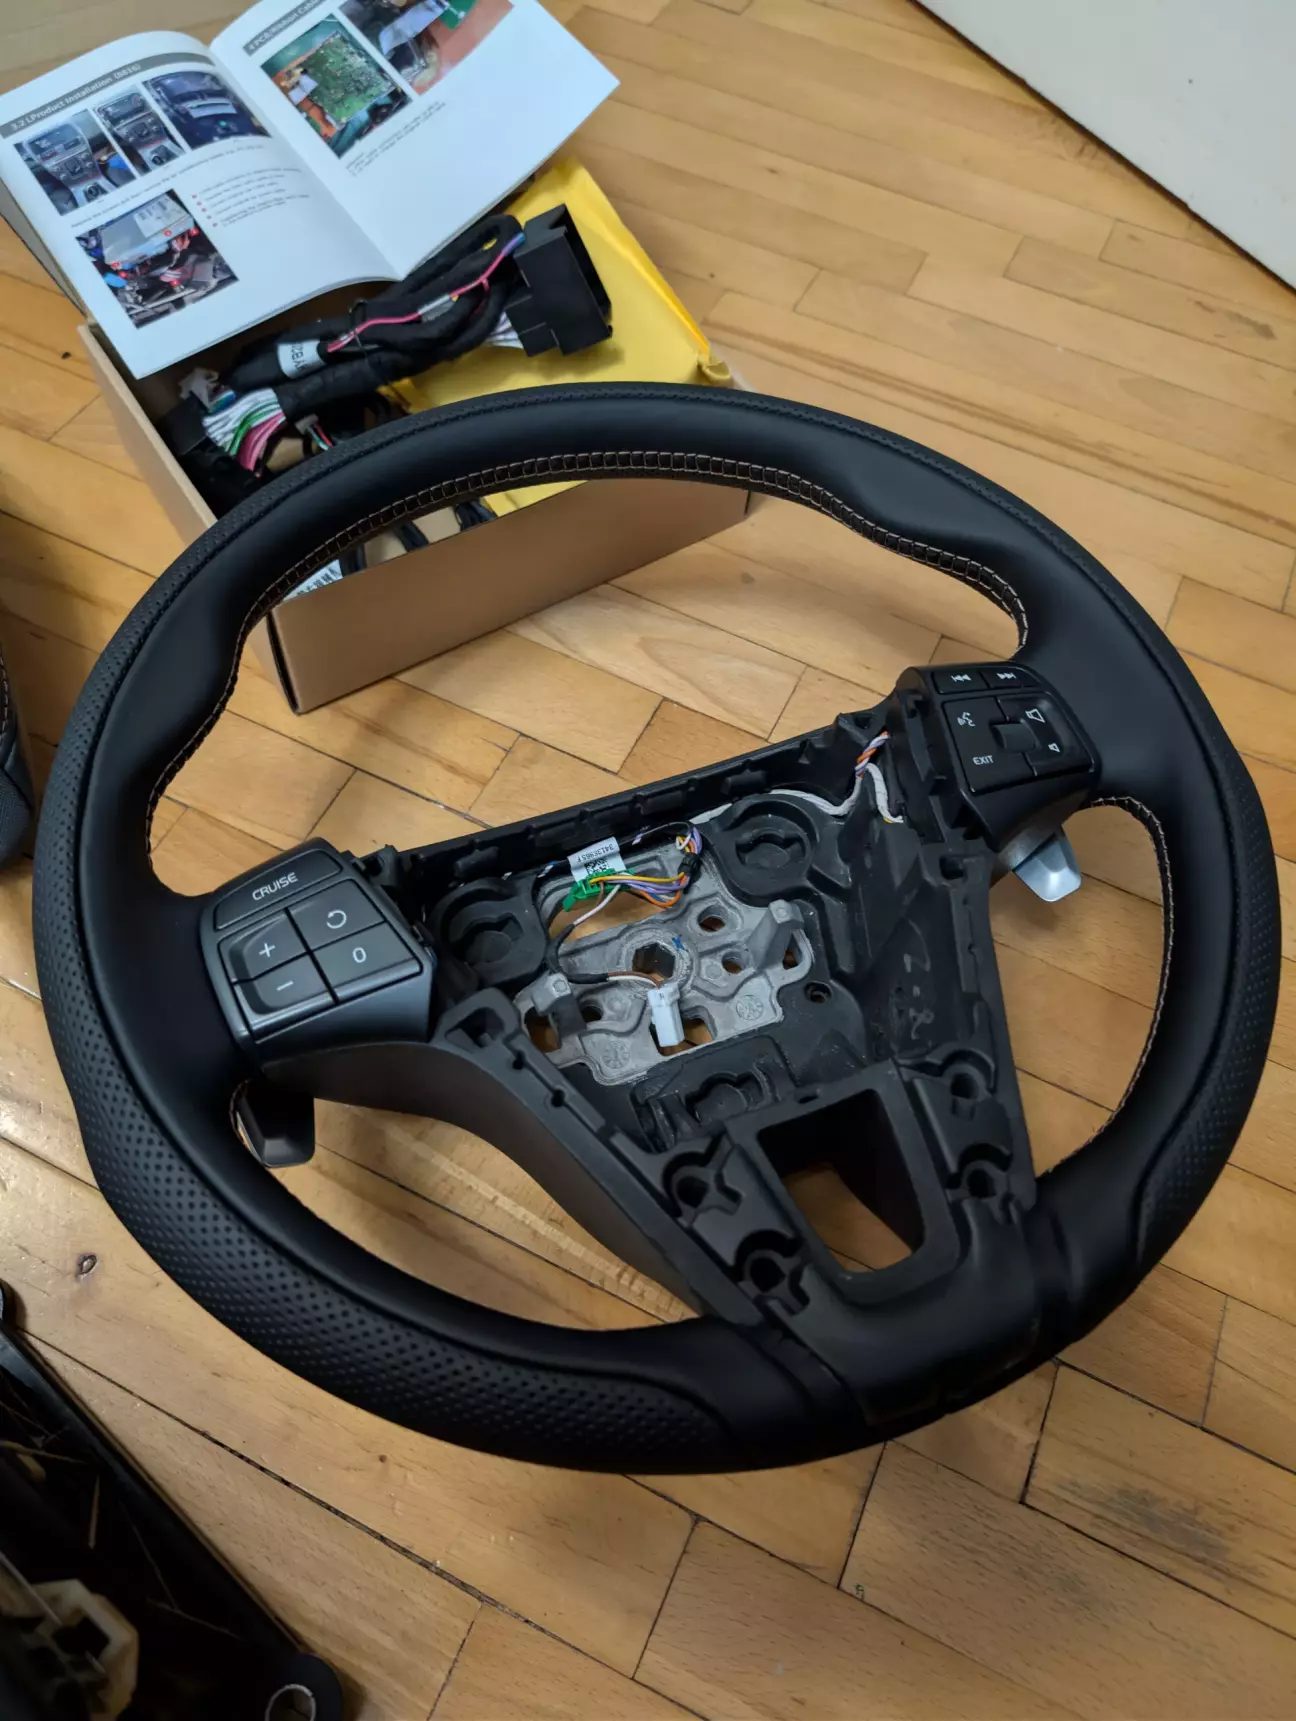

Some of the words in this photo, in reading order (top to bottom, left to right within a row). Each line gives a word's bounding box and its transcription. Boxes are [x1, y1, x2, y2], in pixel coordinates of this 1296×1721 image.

[65, 77, 113, 104] Installation
[972, 754, 994, 766] EXIT
[252, 872, 298, 900] CRUISE
